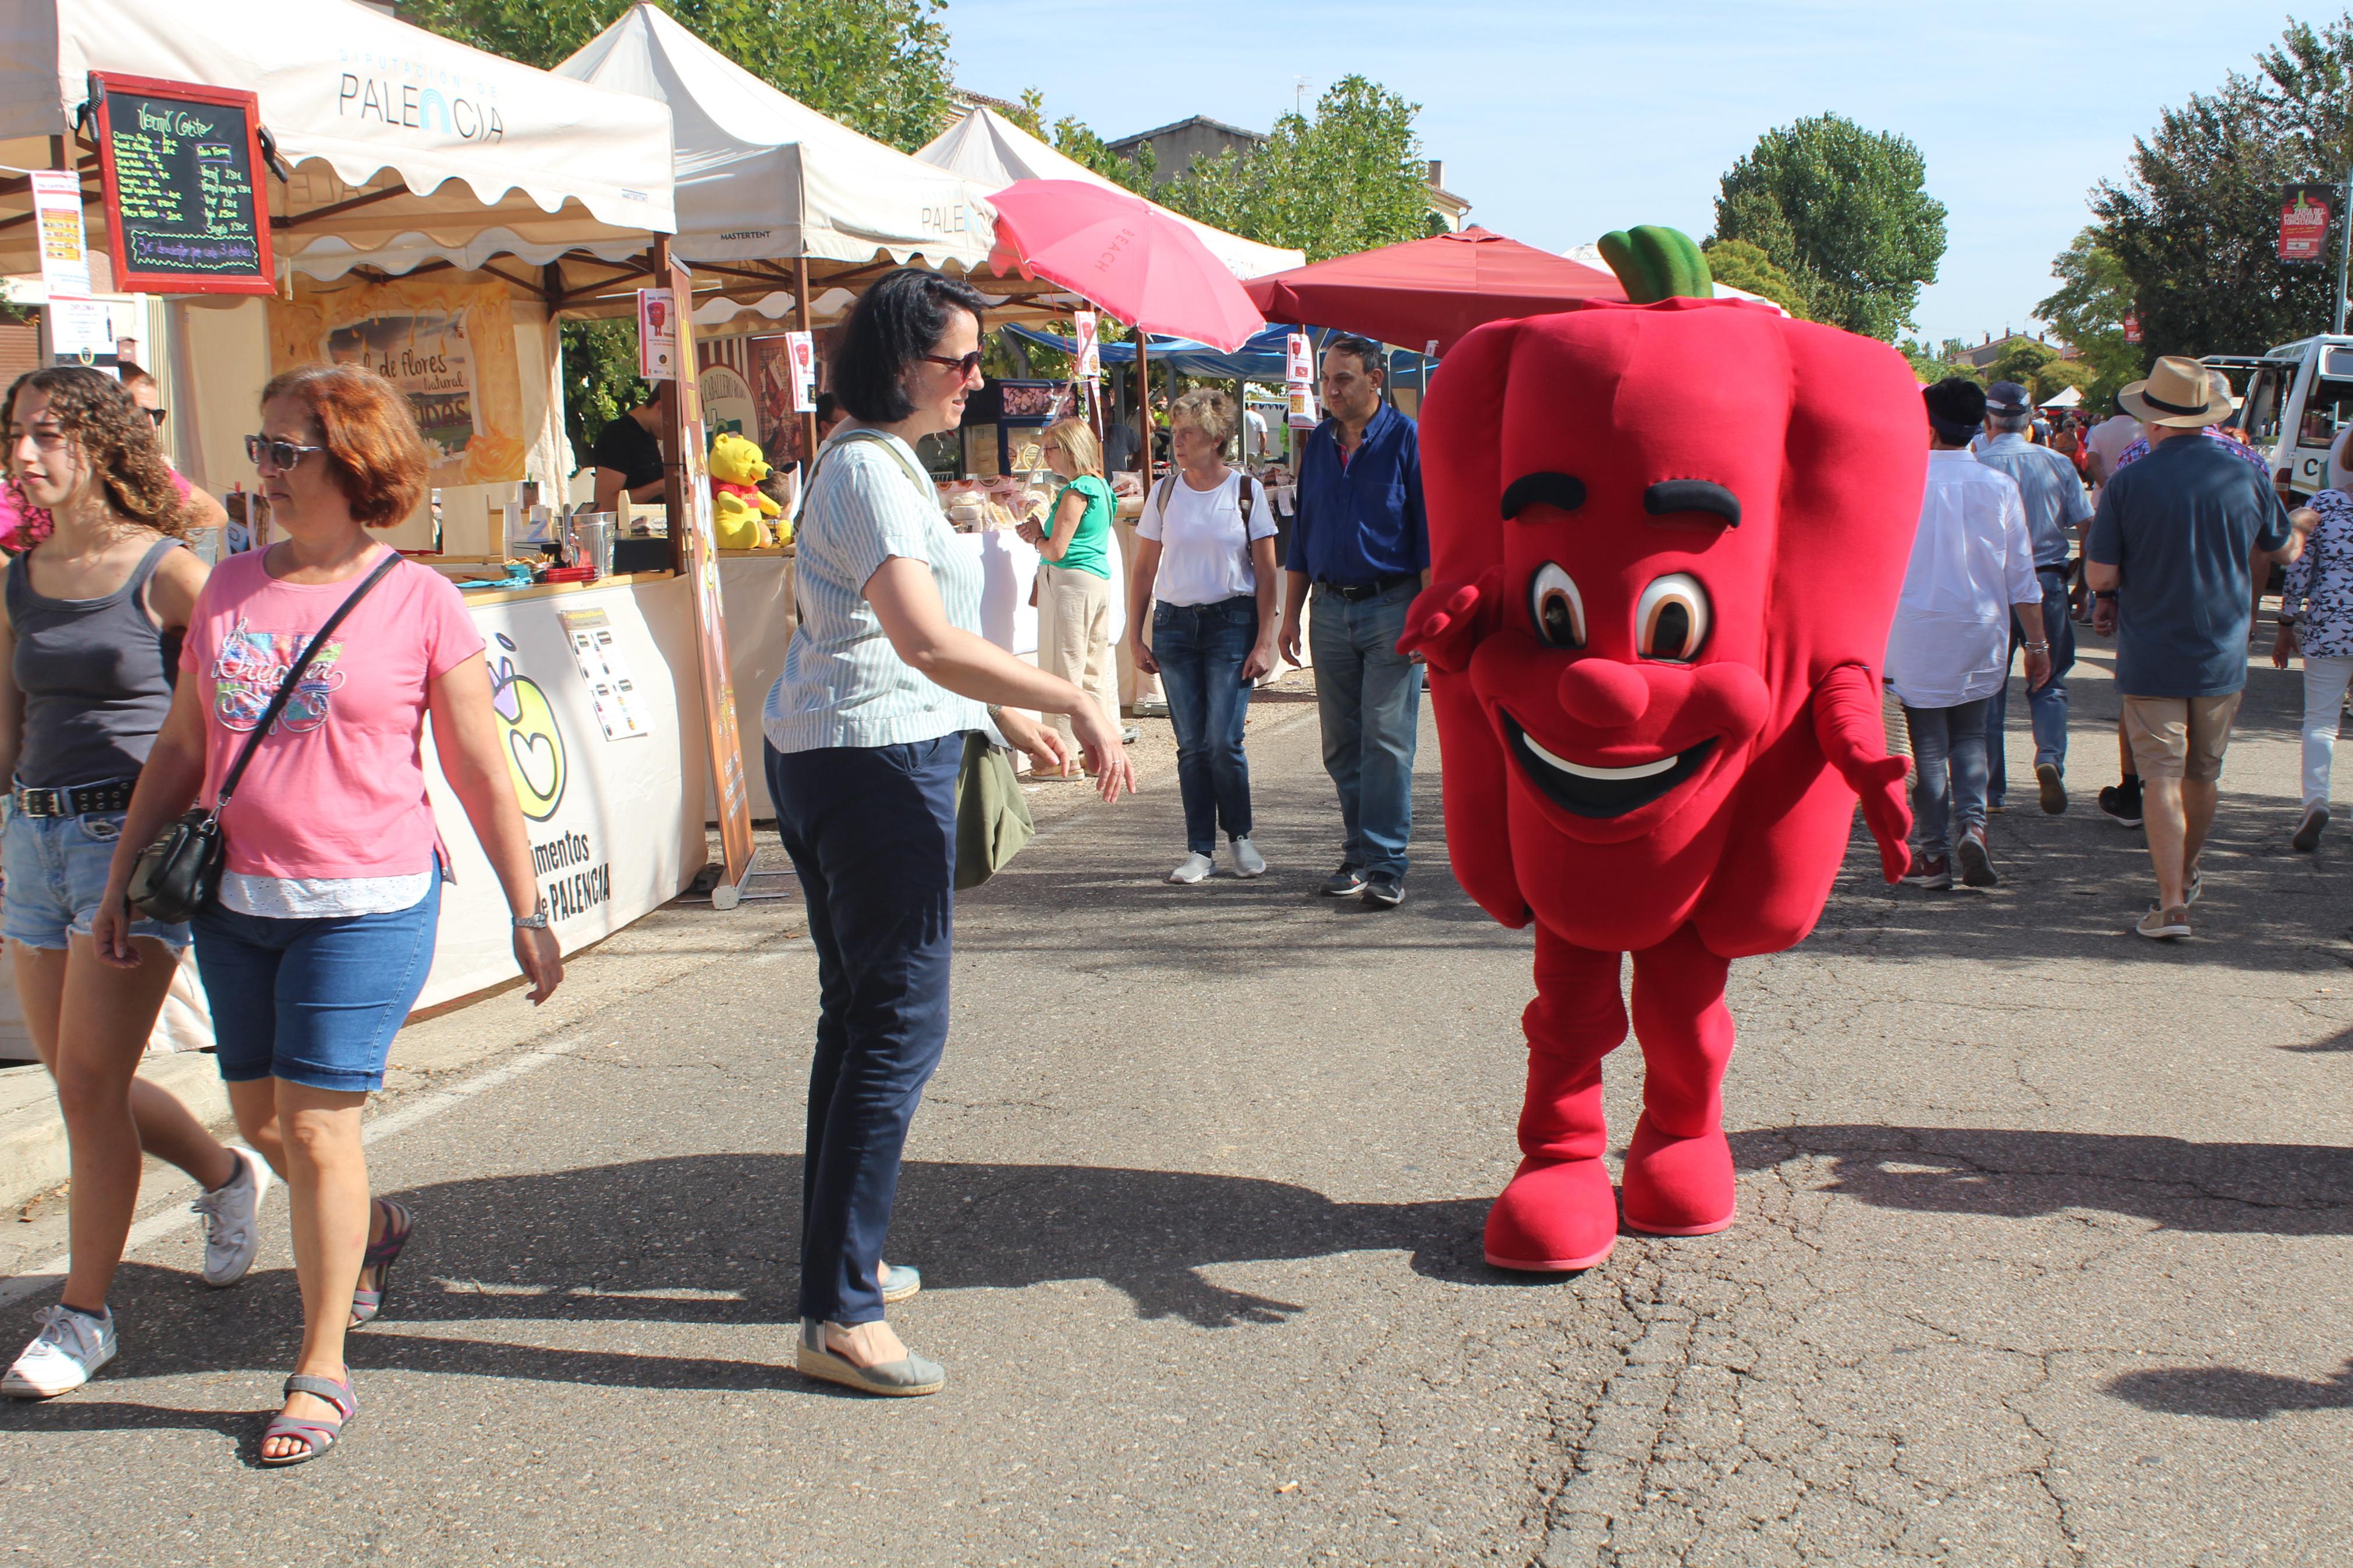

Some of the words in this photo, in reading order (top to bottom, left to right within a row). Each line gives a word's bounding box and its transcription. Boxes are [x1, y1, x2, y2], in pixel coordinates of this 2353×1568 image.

[477, 81, 498, 98] DE
[622, 191, 648, 202] MASTERTENT
[721, 231, 771, 240] MASTERTENT
[1094, 229, 1135, 272] BEACH
[379, 351, 397, 378] de
[401, 349, 448, 377] flores
[424, 371, 464, 391] Natural
[549, 862, 611, 922] PALENCIA
